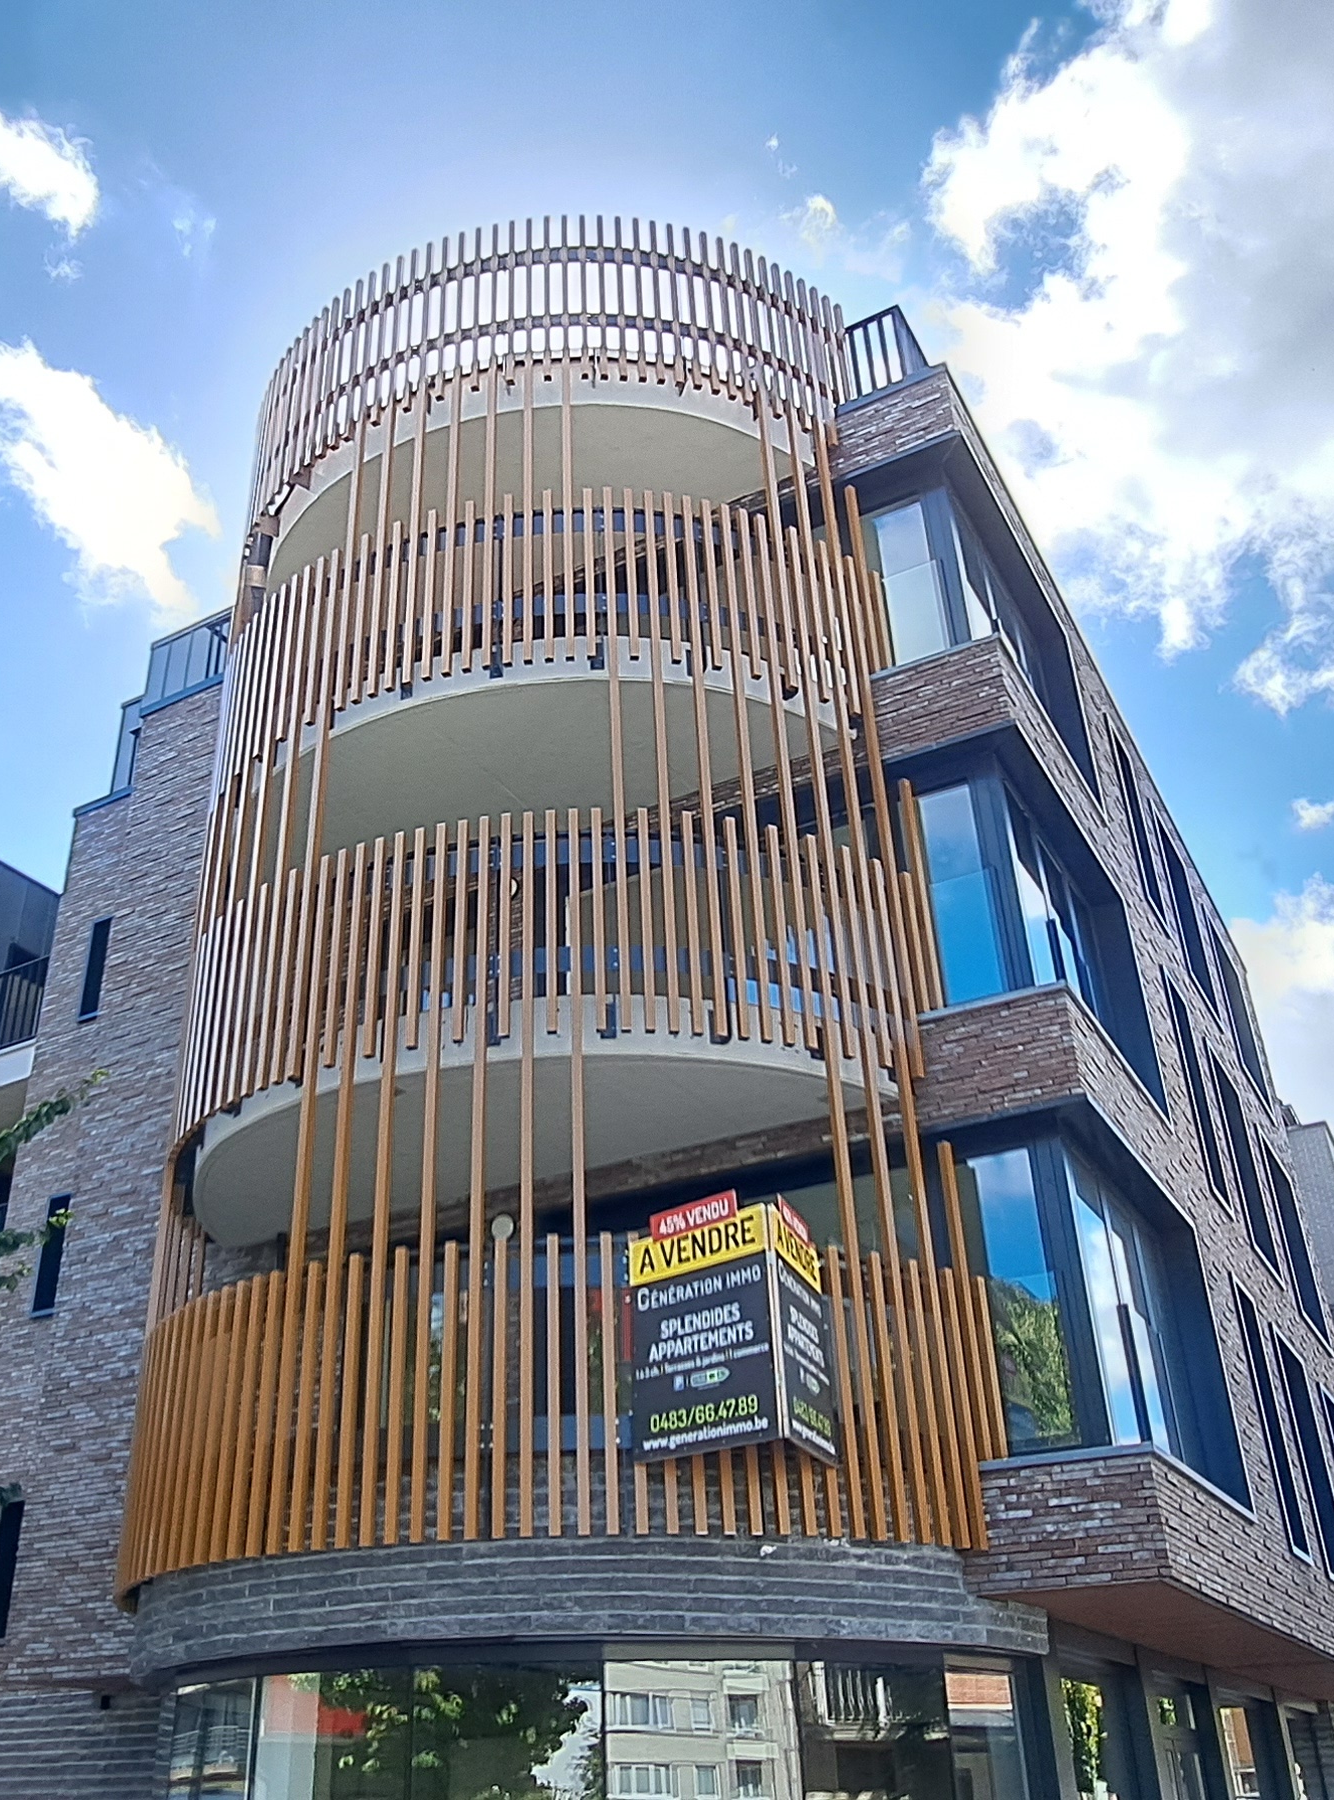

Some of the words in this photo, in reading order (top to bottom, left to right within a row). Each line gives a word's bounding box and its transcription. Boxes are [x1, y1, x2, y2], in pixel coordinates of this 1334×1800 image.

[658, 1212, 686, 1235] 45%
[687, 1198, 729, 1228] VENDU
[659, 1214, 756, 1269] VENDRE
[726, 1264, 762, 1290] IMMO
[660, 1301, 741, 1340] SPLENDIDES
[648, 1320, 754, 1363] APPARTEMENTS
[642, 1415, 769, 1451] www.generationimmo.be
[650, 1394, 758, 1433] 0483/66.47.89
